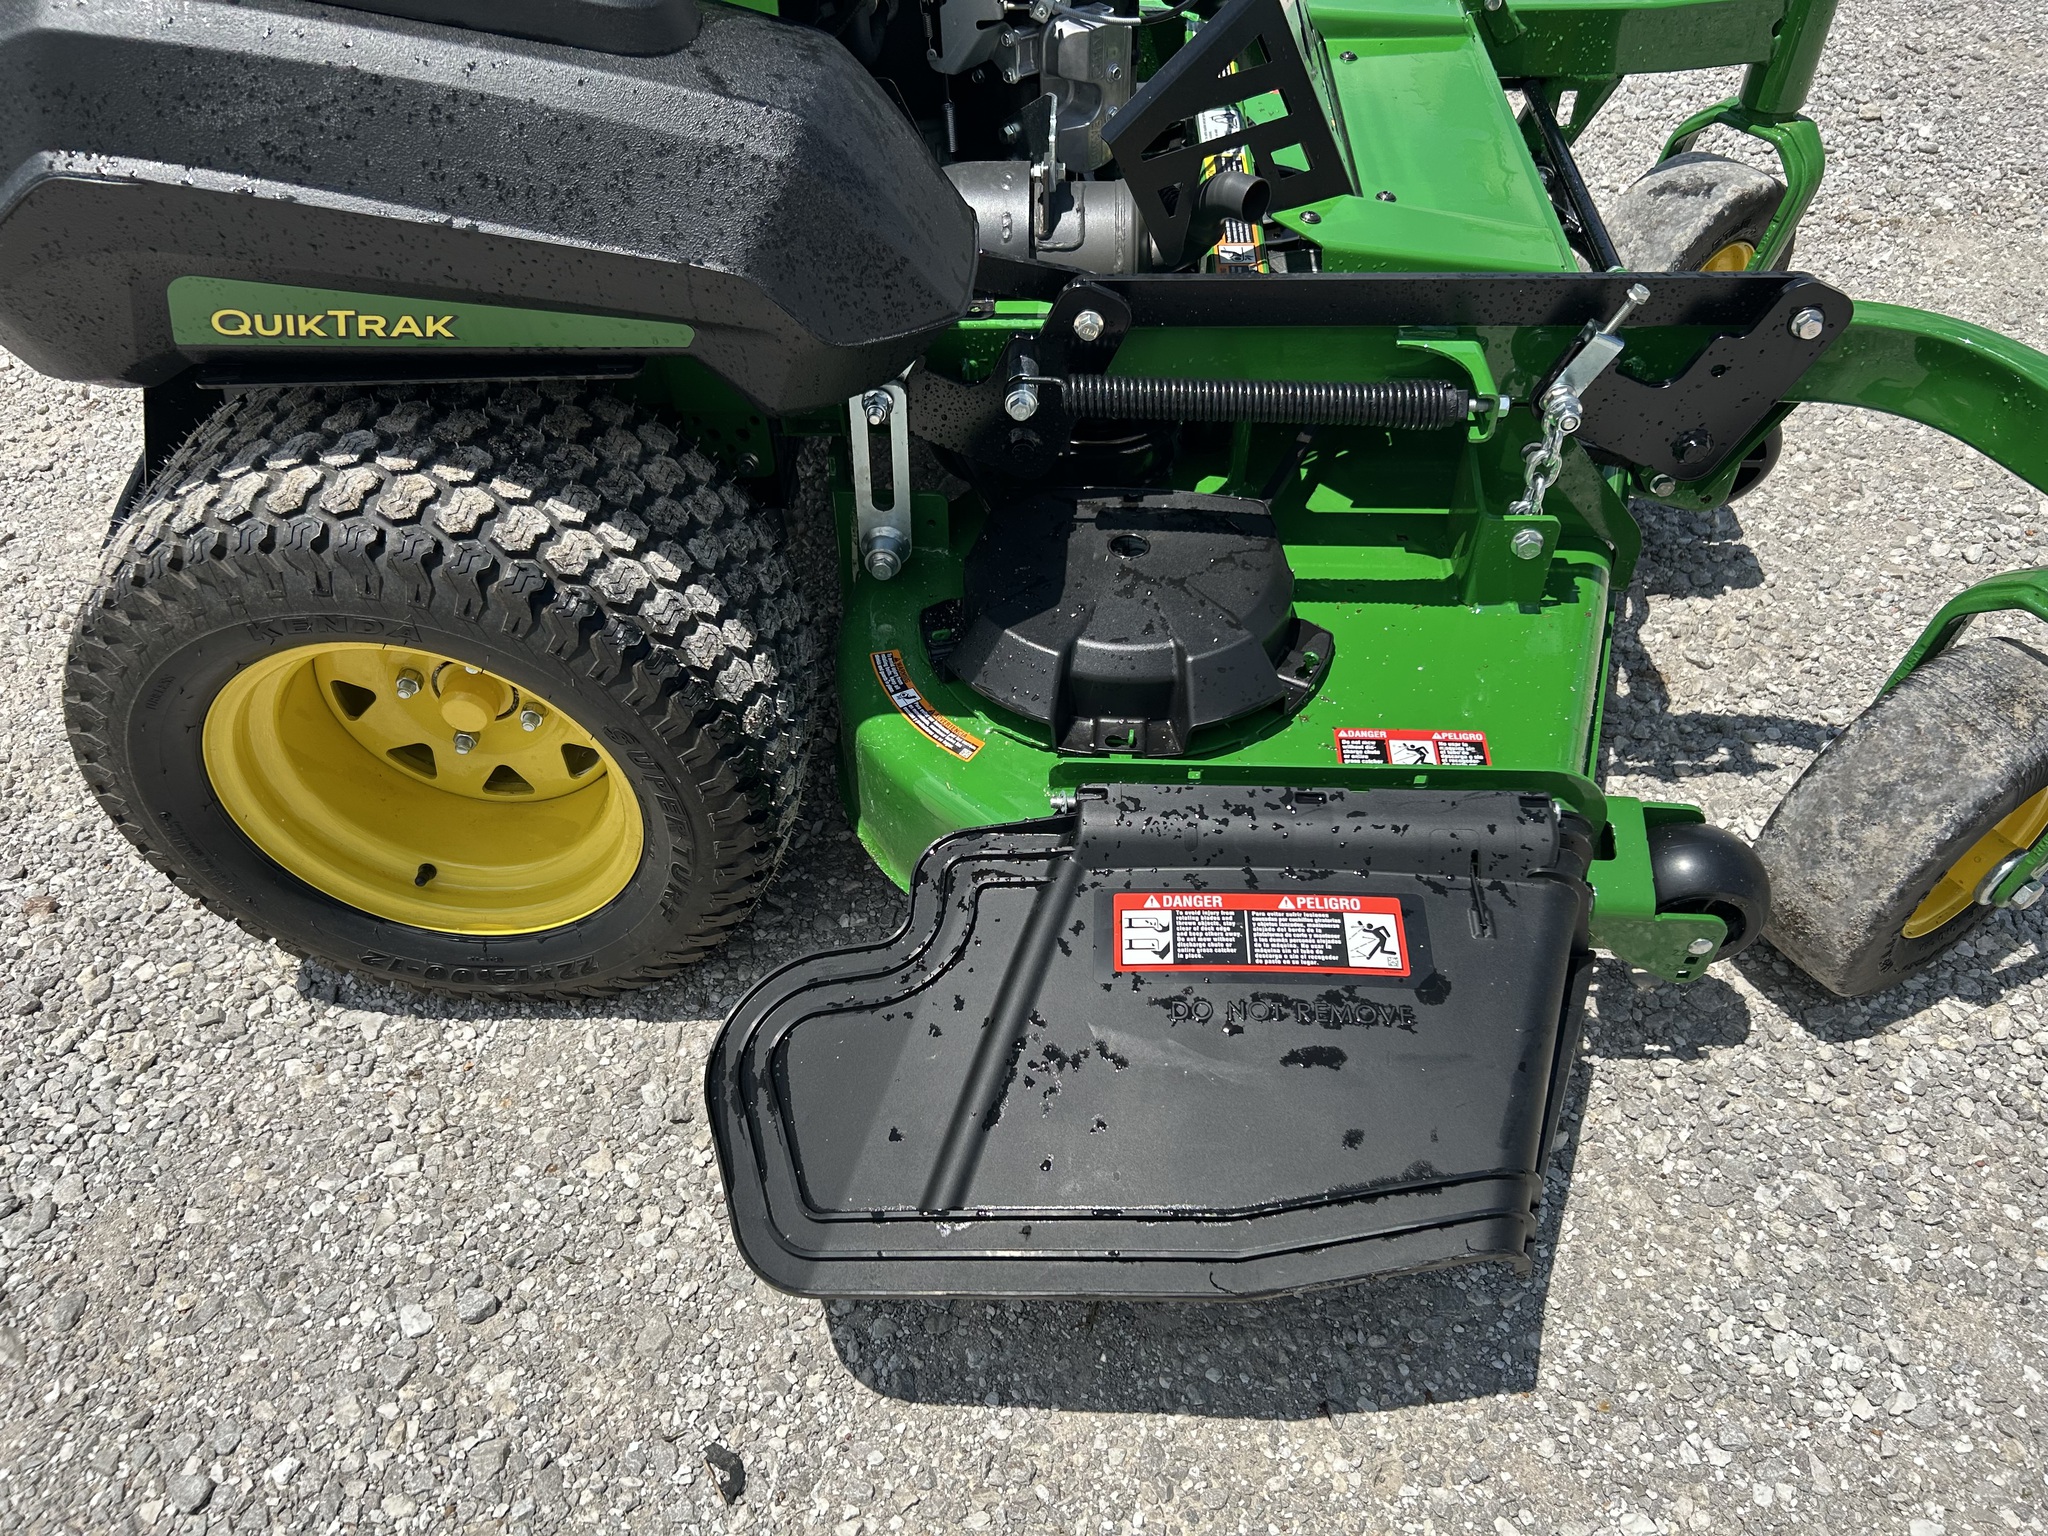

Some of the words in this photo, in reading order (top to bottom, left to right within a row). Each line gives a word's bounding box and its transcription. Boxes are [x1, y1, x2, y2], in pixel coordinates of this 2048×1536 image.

[210, 309, 455, 338] QUIKTRAK
[246, 615, 422, 643] KENDA
[1348, 730, 1387, 738] DANGER
[1442, 732, 1483, 740] PELIGRO
[603, 725, 690, 838] SUPER
[1162, 895, 1223, 908] DANGER
[1296, 897, 1361, 911] PELIGRO
[1171, 1000, 1213, 1020] DO
[1227, 1000, 1284, 1021] NOT
[1296, 1001, 1414, 1024] REMOVE
